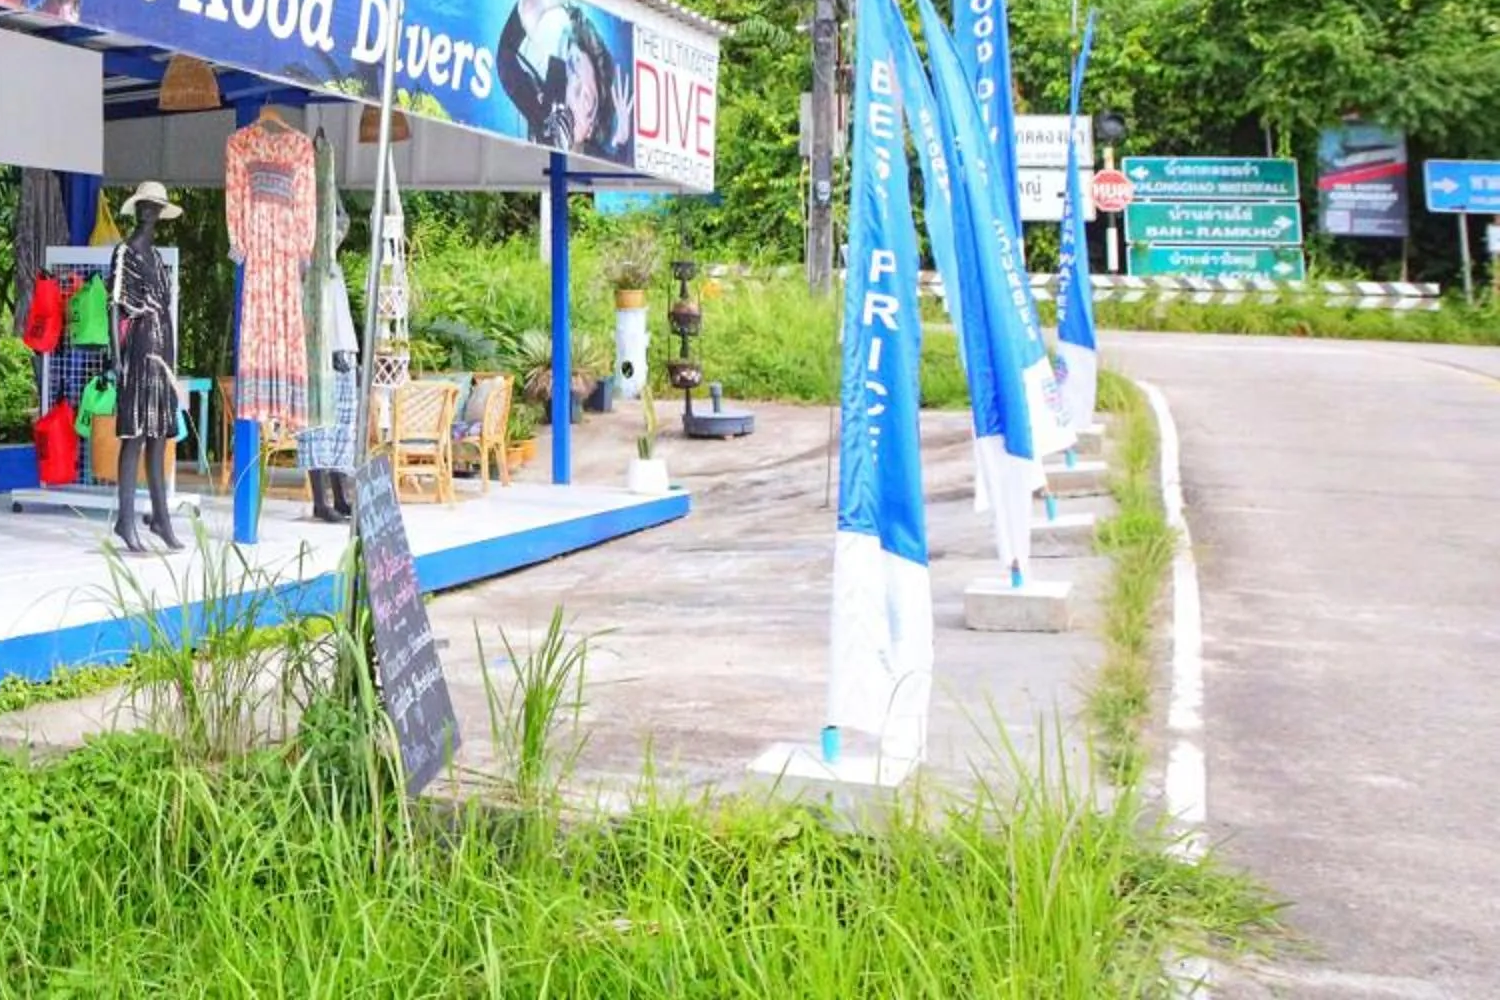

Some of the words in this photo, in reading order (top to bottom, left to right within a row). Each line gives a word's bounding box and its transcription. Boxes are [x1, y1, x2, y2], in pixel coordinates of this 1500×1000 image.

[636, 25, 660, 60] THE
[661, 37, 715, 84] ULTIMATE
[635, 60, 713, 157] DIVE
[636, 141, 712, 191] EXPERIENCE
[1145, 226, 1183, 237] BAN
[1057, 252, 1077, 321] WATER
